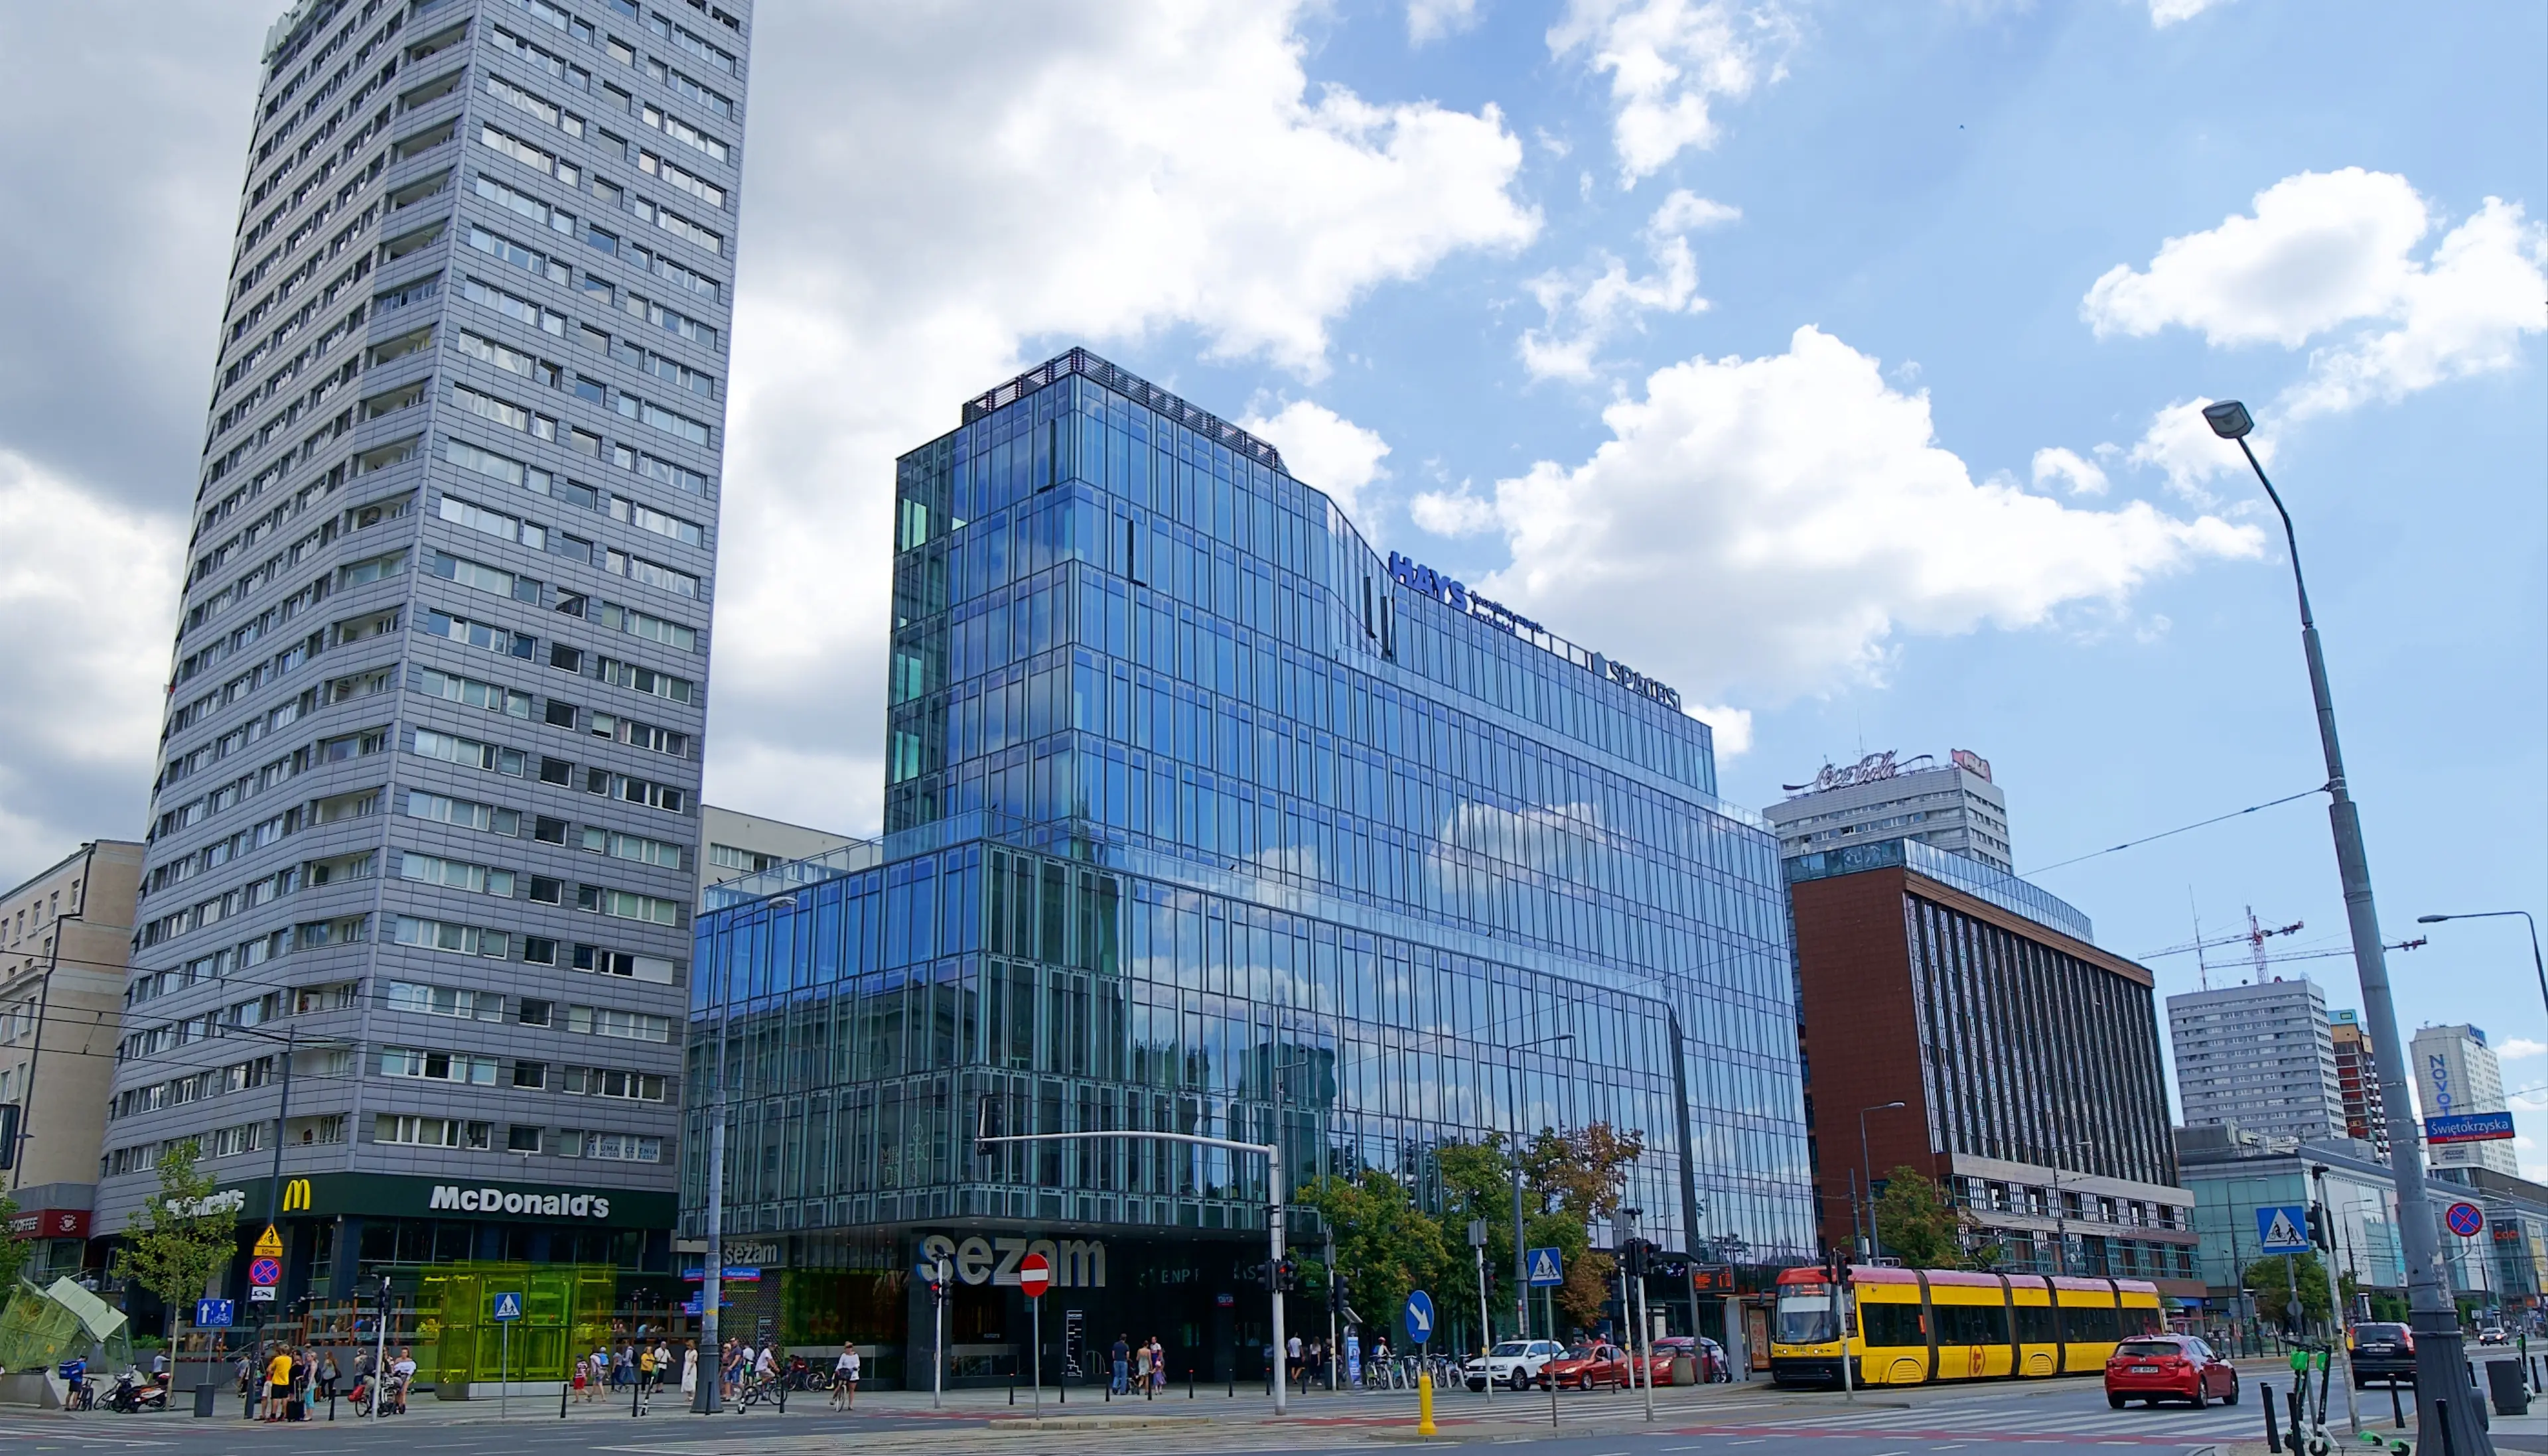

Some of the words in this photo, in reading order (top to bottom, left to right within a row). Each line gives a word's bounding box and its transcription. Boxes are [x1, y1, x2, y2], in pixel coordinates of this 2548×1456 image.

[1389, 551, 1467, 612] HAYS
[1610, 661, 1677, 710] SPACES
[2429, 1054, 2451, 1116] NOVOT
[2431, 1118, 2509, 1135] Świętokrzyska
[429, 1185, 609, 1218] McDonald's
[2338, 1225, 2360, 1240] ZRA
[724, 1244, 777, 1265] sezam
[916, 1234, 1105, 1287] sezam
